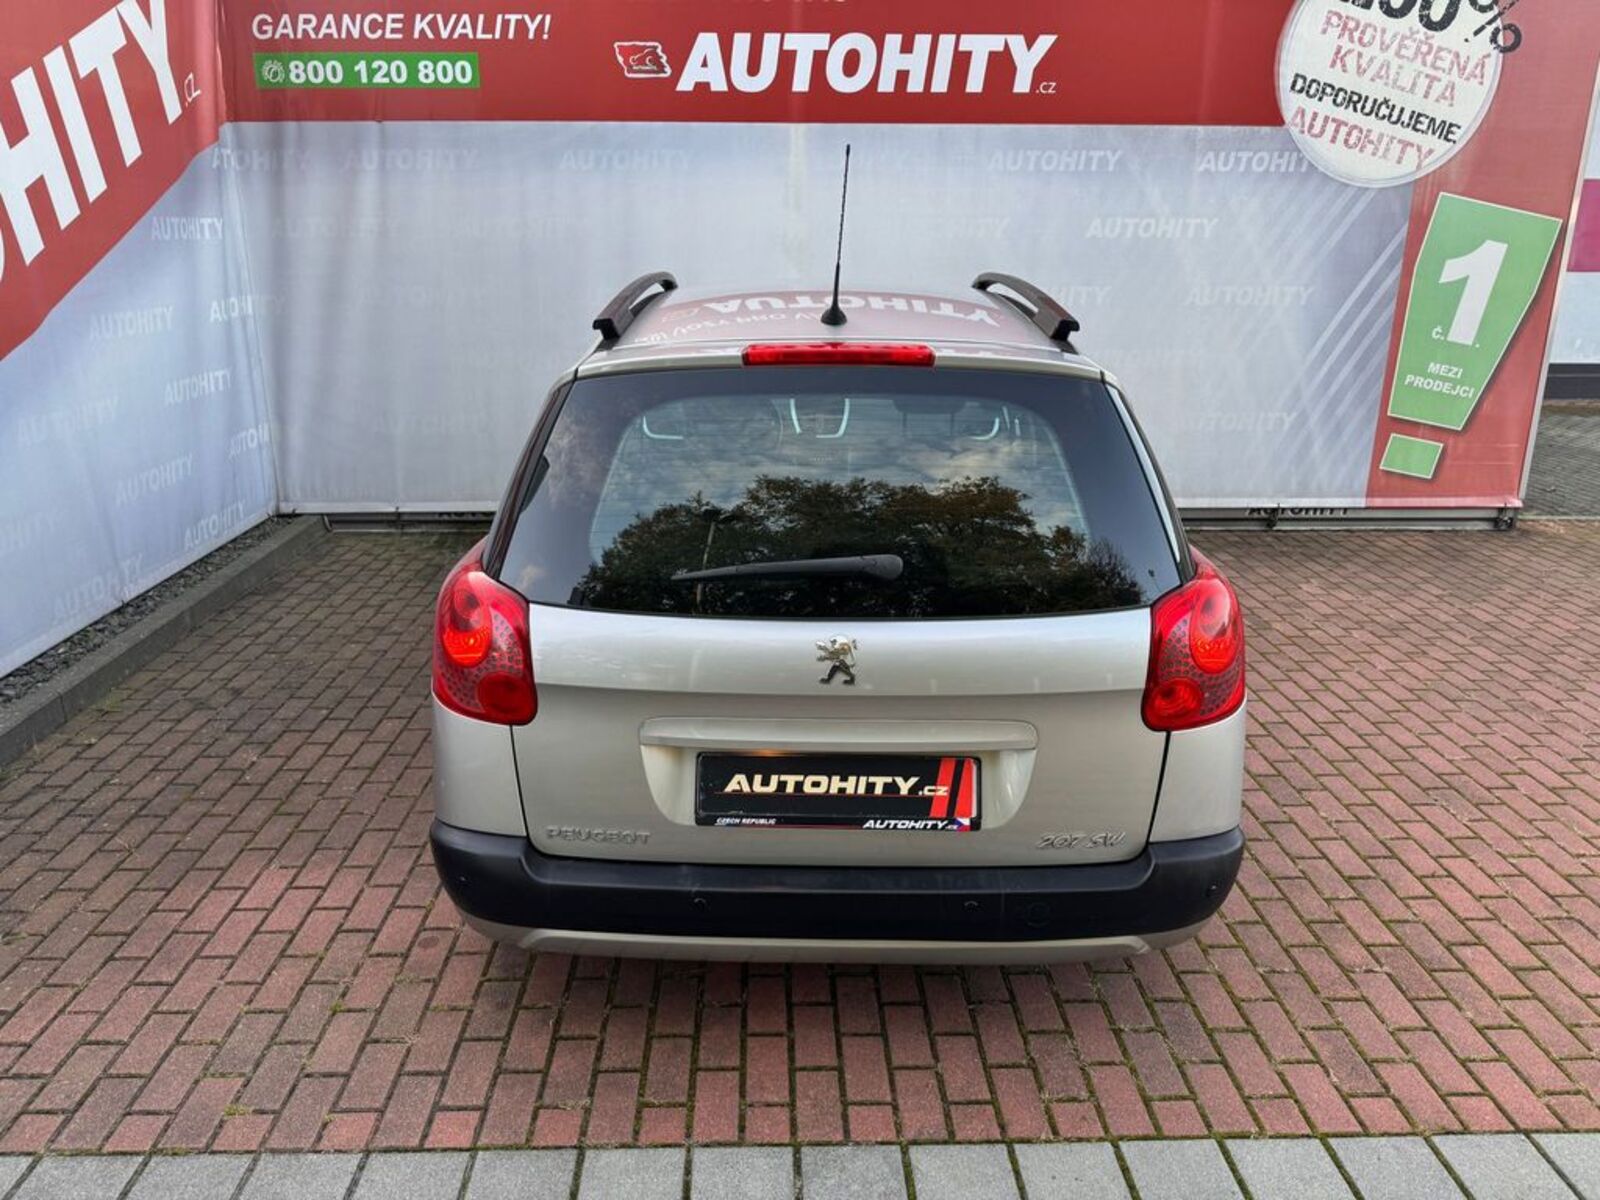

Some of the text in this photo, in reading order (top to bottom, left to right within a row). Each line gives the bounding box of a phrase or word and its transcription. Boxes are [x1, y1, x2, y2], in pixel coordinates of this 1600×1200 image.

[252, 13, 552, 40] GARANCE KVALITY!
[1320, 9, 1492, 86] PROVĚŘENÁ
[288, 60, 473, 84] 800 120 800
[1328, 44, 1457, 107] KVALITA
[1289, 72, 1461, 144] DOPORUČUJEME
[1289, 106, 1434, 171] AUTOHITY
[987, 148, 1122, 172] AUTOHITY
[1199, 151, 1312, 173] AUTOHIT
[150, 216, 223, 241] AUTOHITY
[1085, 217, 1218, 240] AUTOHITY
[88, 306, 174, 341] AUTOHITY
[1427, 361, 1463, 379] MEZI
[163, 367, 232, 407] AUTOHITY
[1404, 373, 1475, 399] PRODEJCI
[115, 453, 194, 506] AUTOHITY
[724, 773, 950, 796] AUTOHITY.cz
[546, 825, 651, 844] PEUGEOT
[1036, 831, 1126, 850] 207 SW
